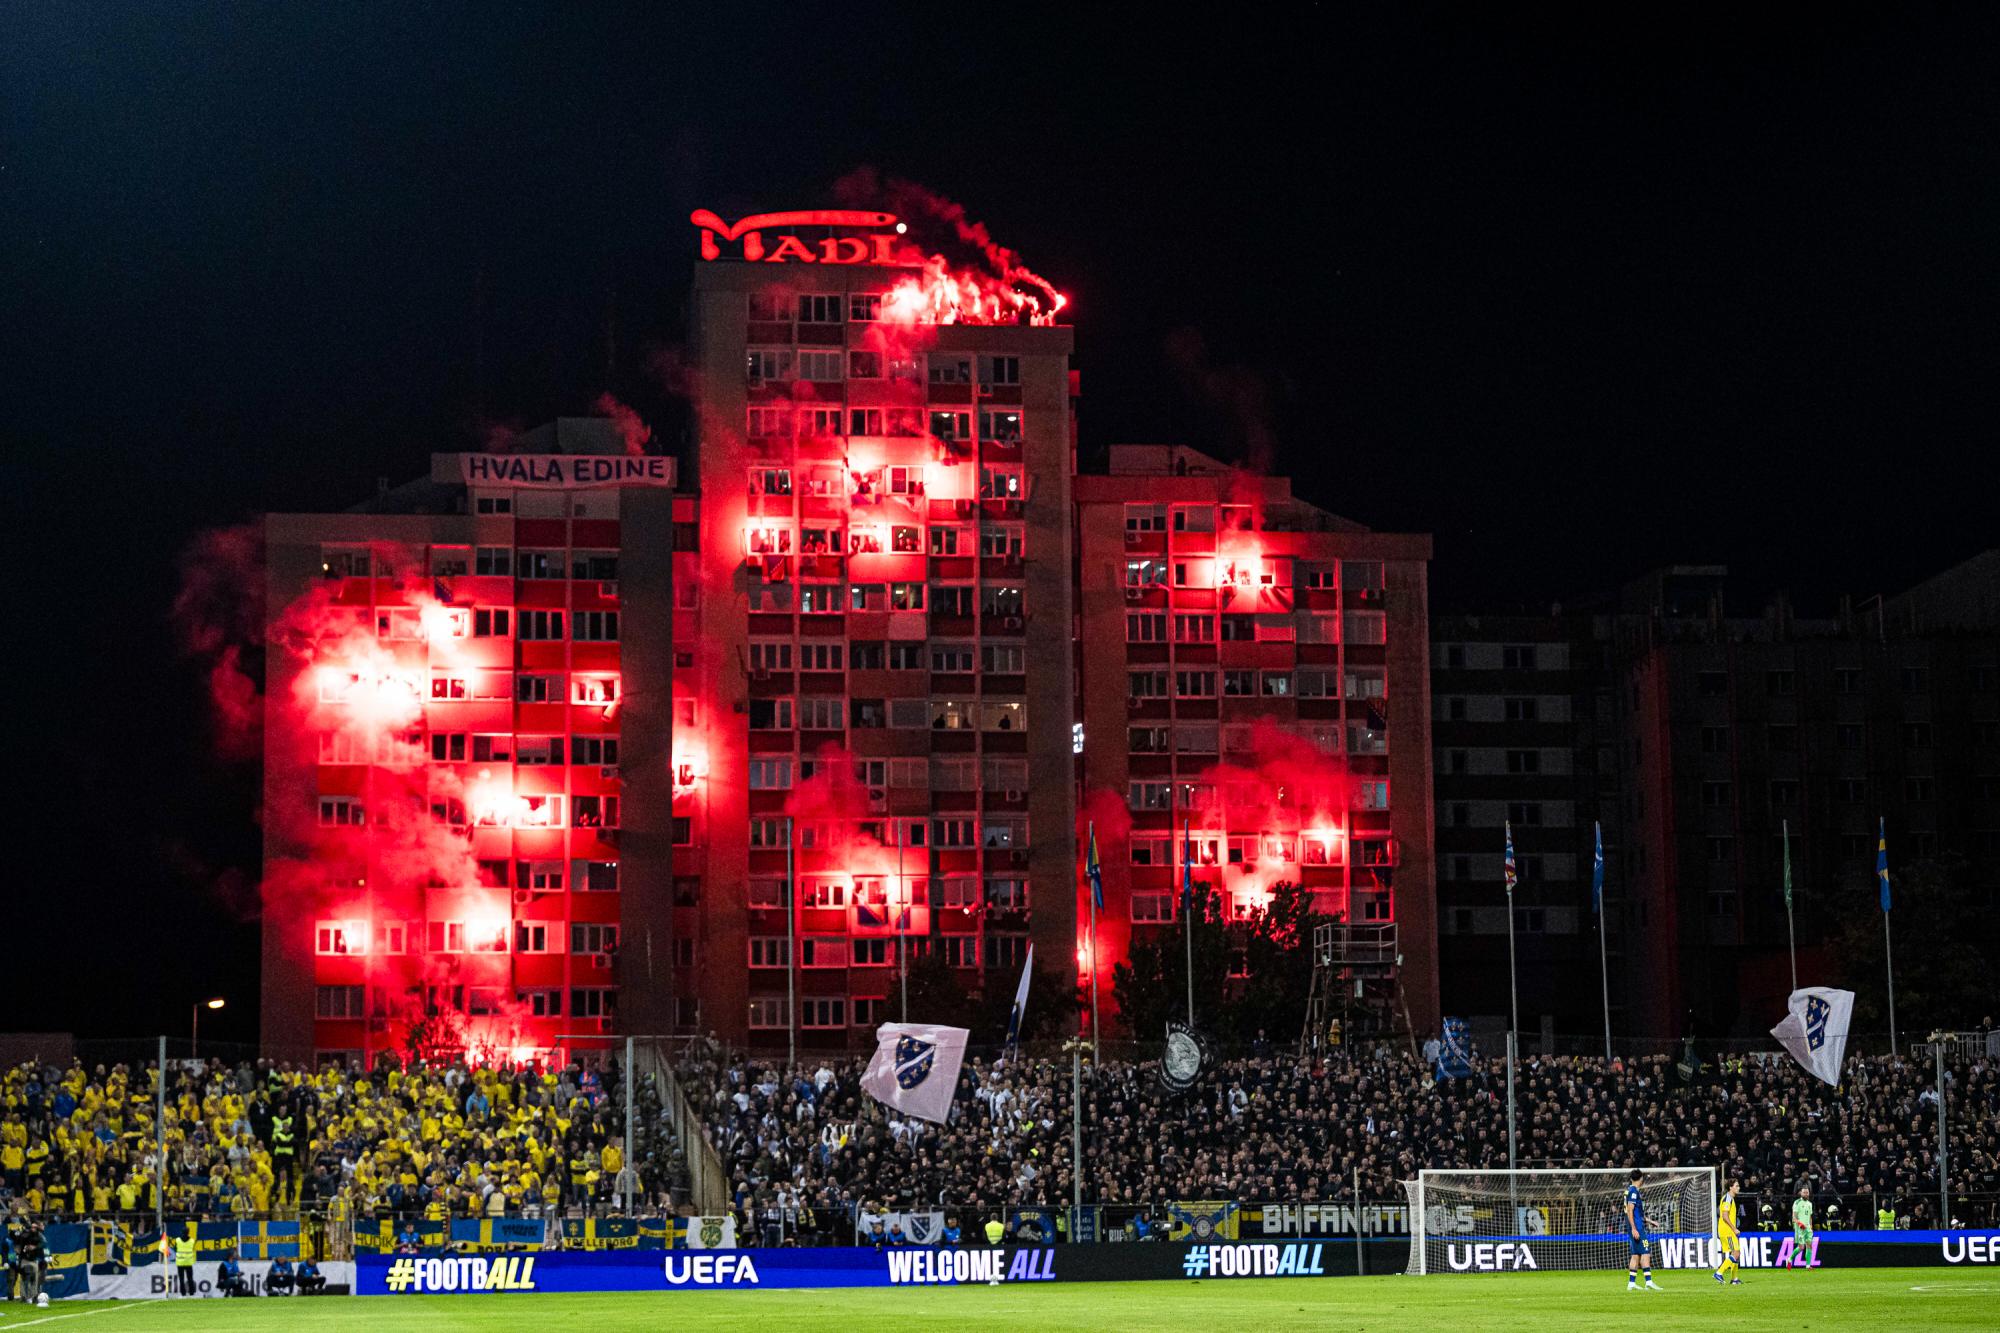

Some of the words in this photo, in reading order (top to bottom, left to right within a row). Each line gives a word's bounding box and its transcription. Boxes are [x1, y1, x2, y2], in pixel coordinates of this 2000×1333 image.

[469, 457, 564, 483] HVALA
[573, 458, 665, 482] EDINE
[887, 1249, 1006, 1283] WELCOME
[1007, 1248, 1056, 1280] ALL
[1183, 1244, 1325, 1276] #FOOTBALL
[1447, 1243, 1538, 1270] UEFA
[1660, 1236, 1773, 1268] WELCME
[386, 1256, 536, 1292] #FOOTBALL
[665, 1254, 760, 1284] UEFA
